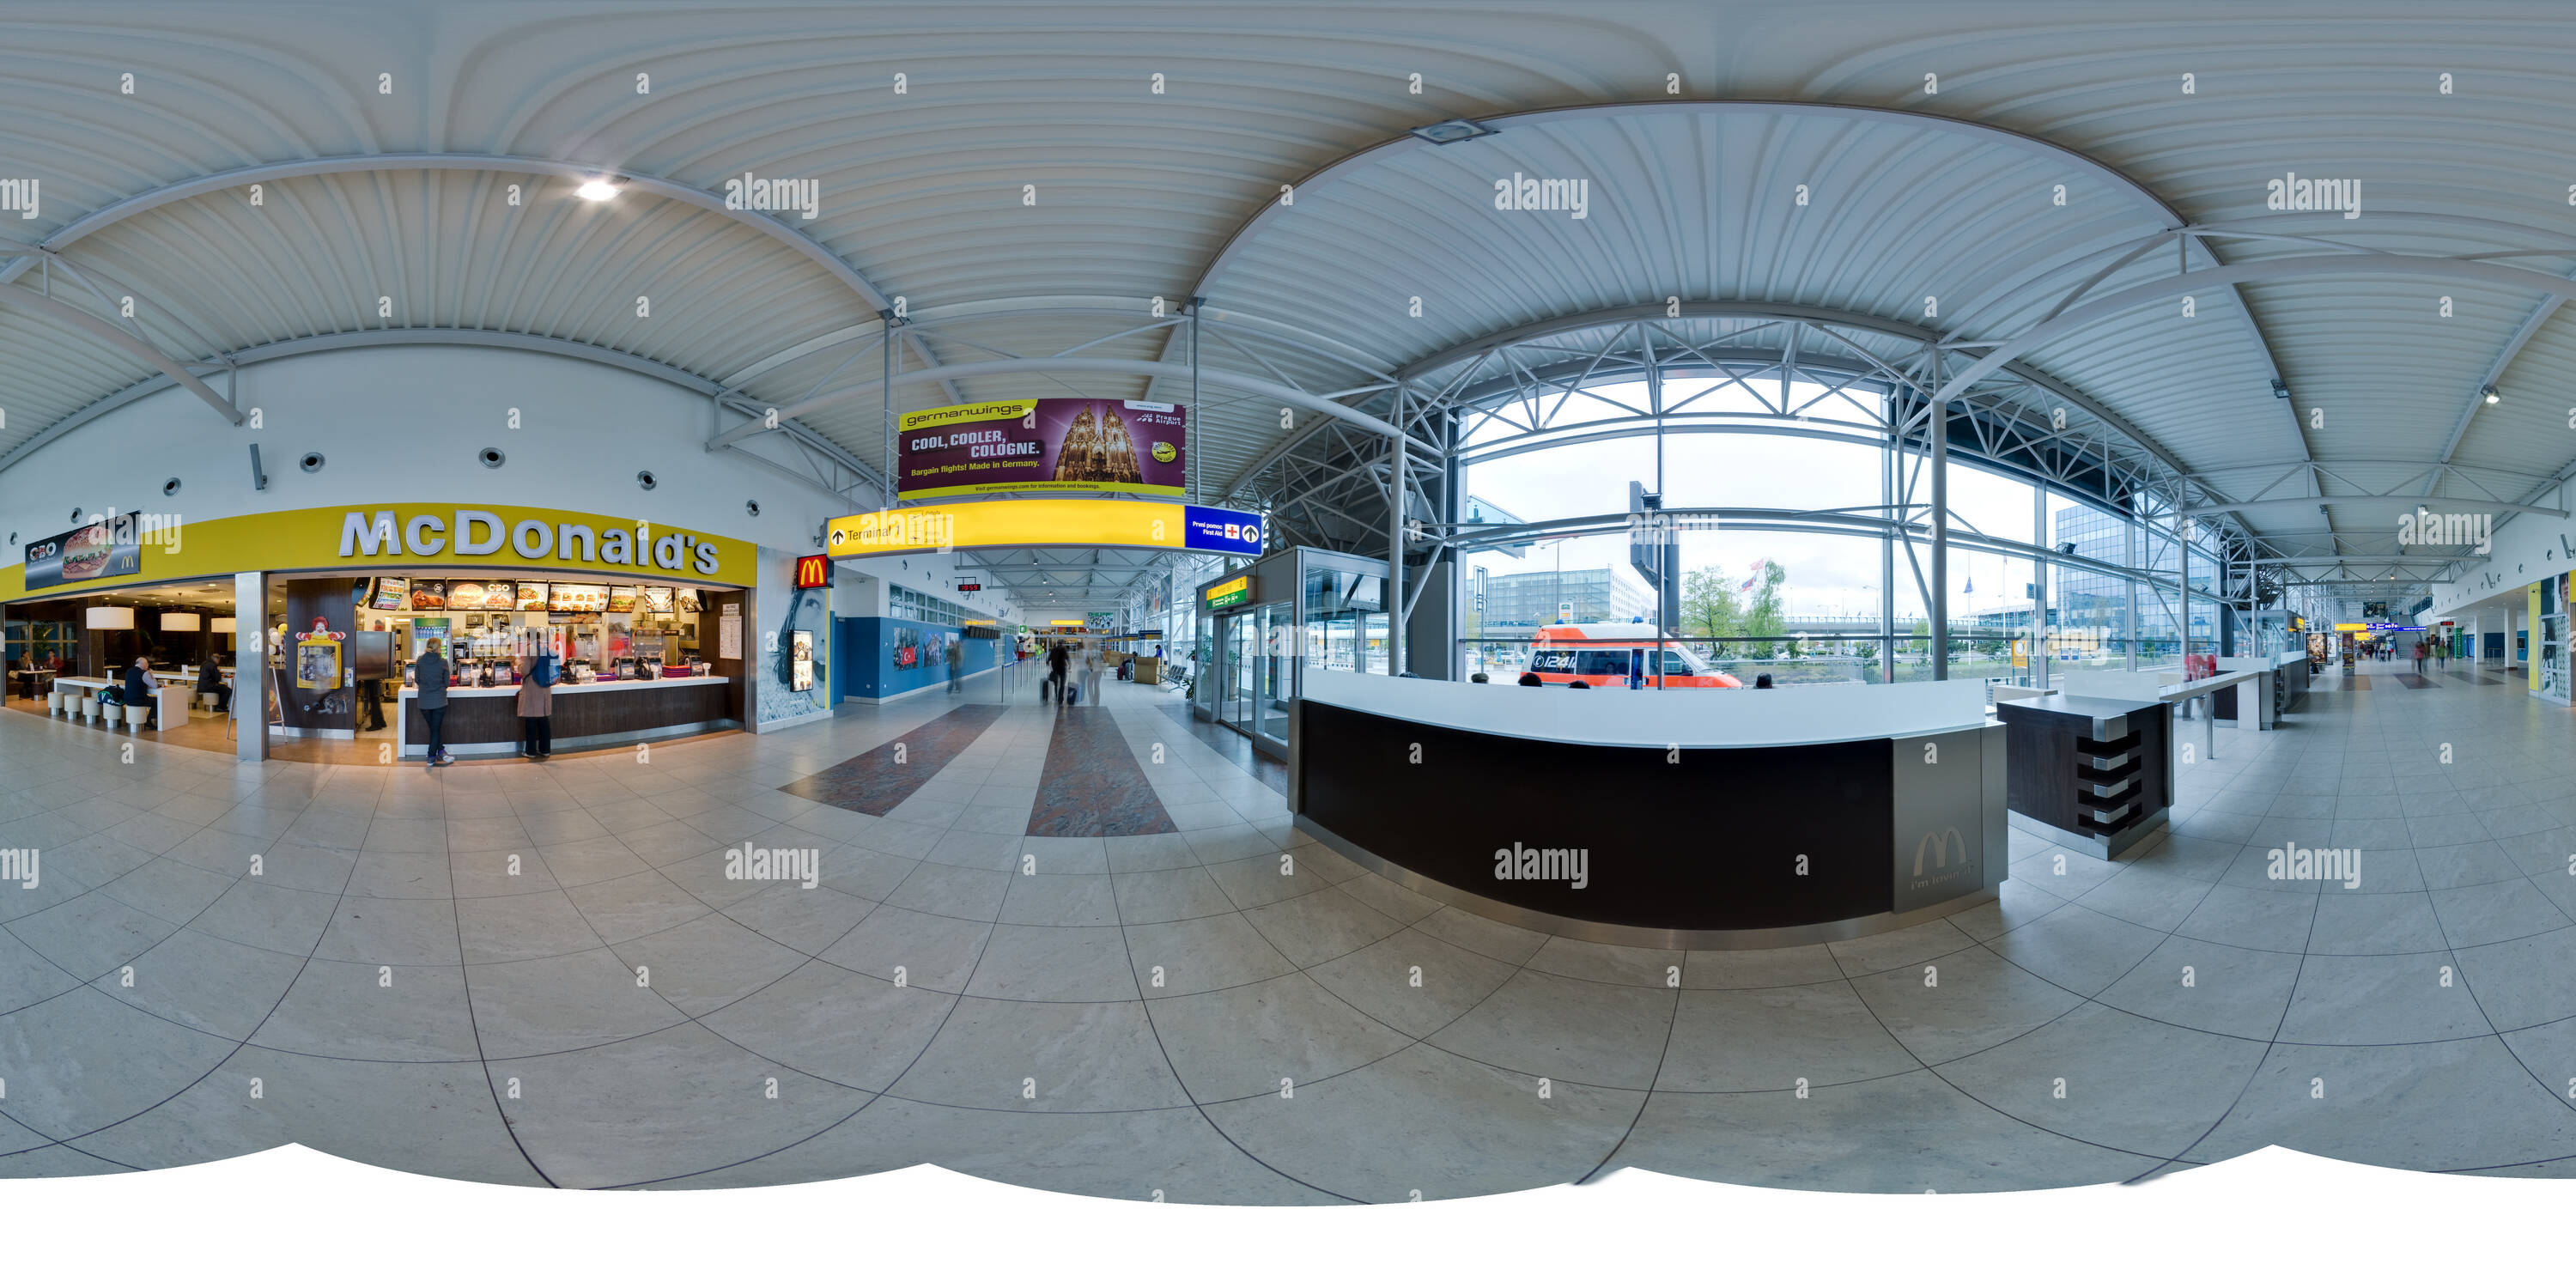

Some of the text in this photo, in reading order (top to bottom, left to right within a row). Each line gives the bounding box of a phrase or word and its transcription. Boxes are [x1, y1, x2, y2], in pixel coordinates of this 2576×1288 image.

[907, 404, 1023, 426] germanwings
[912, 430, 1006, 452] COOL, COOLER,
[971, 442, 1040, 458] COLOGNE.
[911, 466, 939, 477] Bargain
[941, 463, 967, 474] flights!
[969, 462, 990, 471] Made
[1002, 459, 1040, 469] Germany.
[338, 509, 719, 574] McDonald's
[848, 525, 900, 541] Terminal 1
[30, 542, 57, 561] CBO
